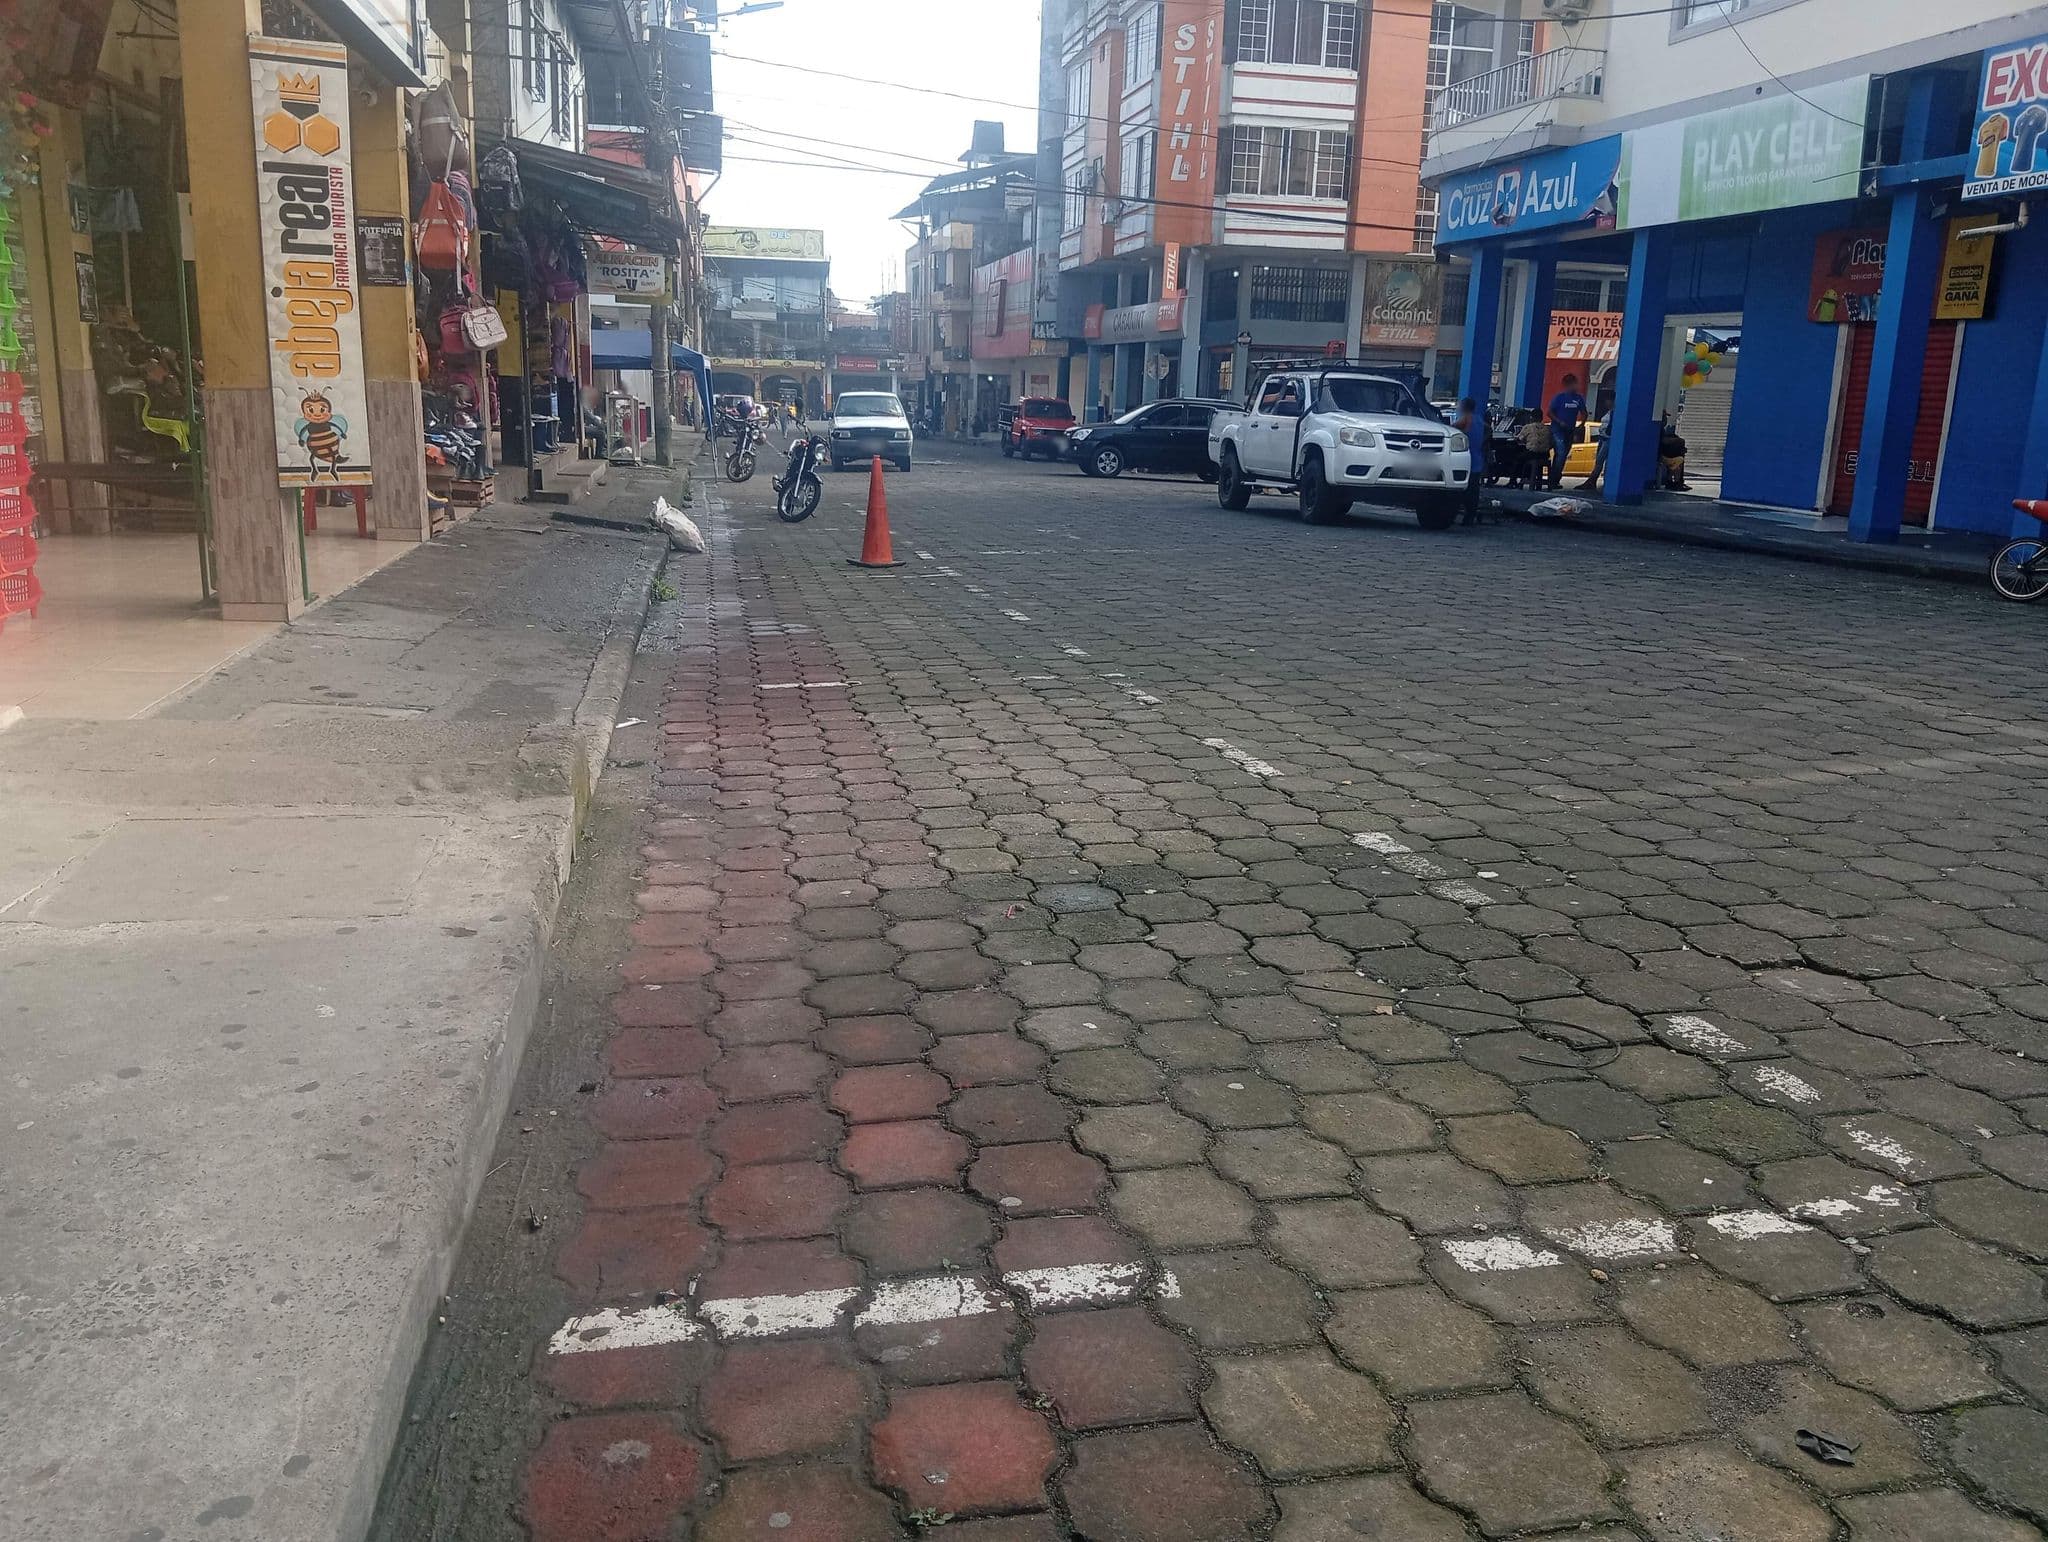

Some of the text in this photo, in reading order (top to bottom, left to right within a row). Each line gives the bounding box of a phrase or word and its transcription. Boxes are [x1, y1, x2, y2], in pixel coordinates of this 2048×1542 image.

[1170, 23, 1197, 182] STIHL
[1199, 19, 1216, 180] STIHL
[1693, 118, 1842, 177] PLAY CELL
[262, 160, 333, 256] real
[329, 167, 347, 230] NATURISTA
[1447, 161, 1577, 230] Cruz Azul
[1967, 181, 1998, 195] VENTA
[2001, 177, 2016, 191] DE
[333, 231, 350, 289] FARMACIA
[358, 226, 403, 238] POTENCIA
[1166, 248, 1177, 292] STIHL
[1945, 290, 1980, 302] GANA
[270, 260, 354, 378] abeja
[1372, 304, 1433, 323] Caranint
[1379, 327, 1419, 339] STIHL
[1557, 339, 1619, 360] STIH
